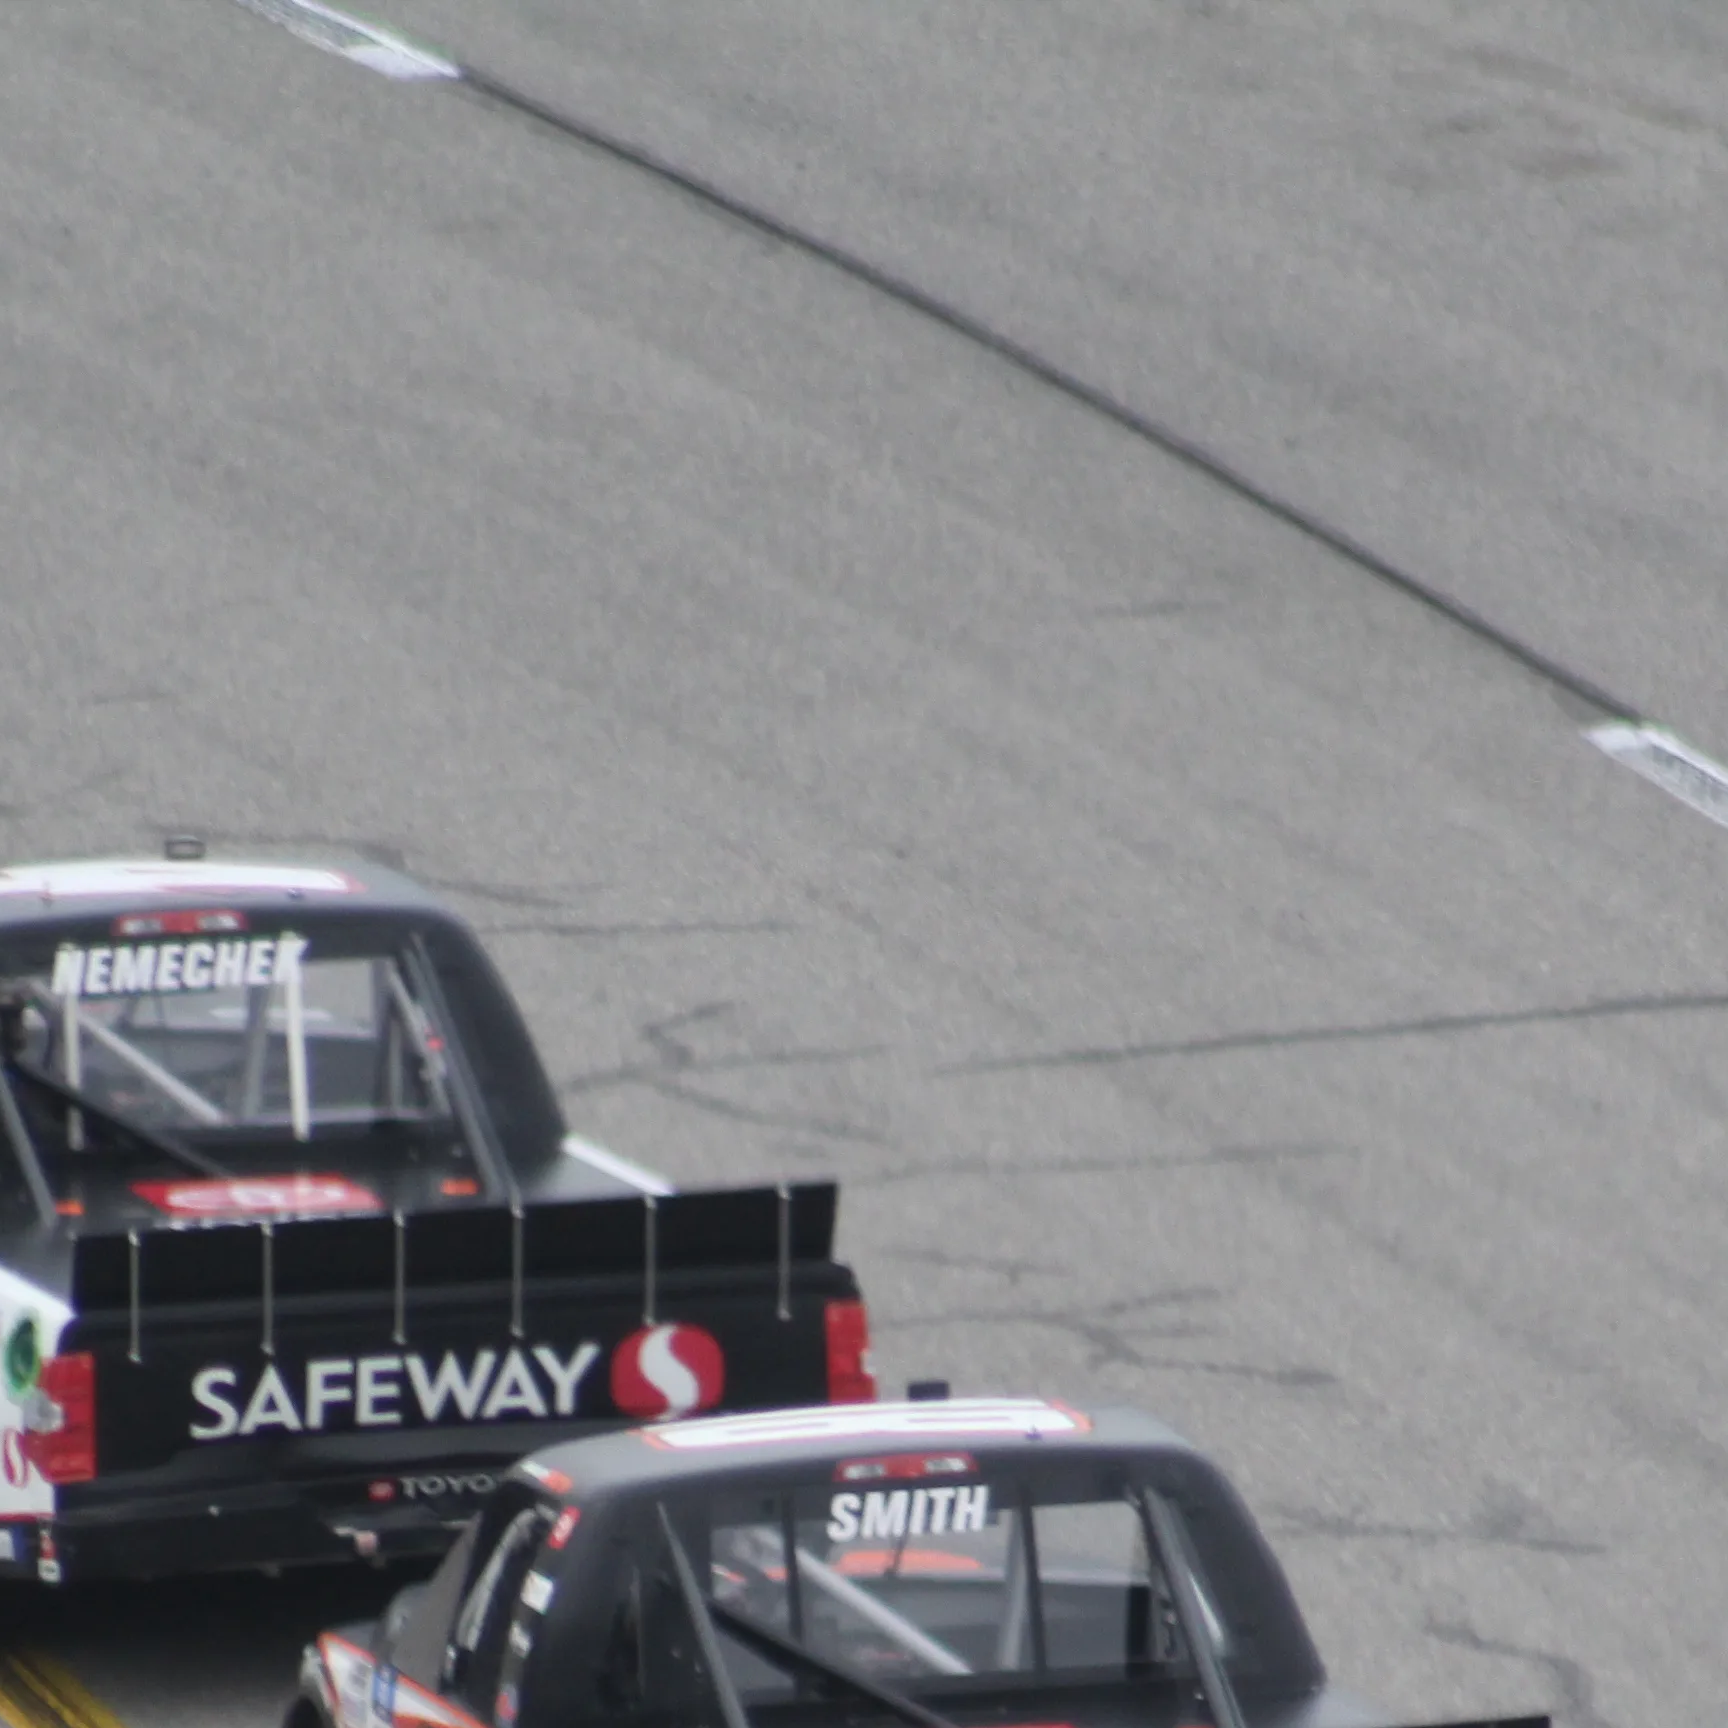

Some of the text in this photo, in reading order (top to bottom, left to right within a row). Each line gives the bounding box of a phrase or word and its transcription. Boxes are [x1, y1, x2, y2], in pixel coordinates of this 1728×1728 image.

[53, 936, 310, 995] NEMECHEK
[188, 1341, 600, 1440] SAFEWAY
[399, 1473, 504, 1499] TOYO
[826, 1484, 989, 1544] SMITH
